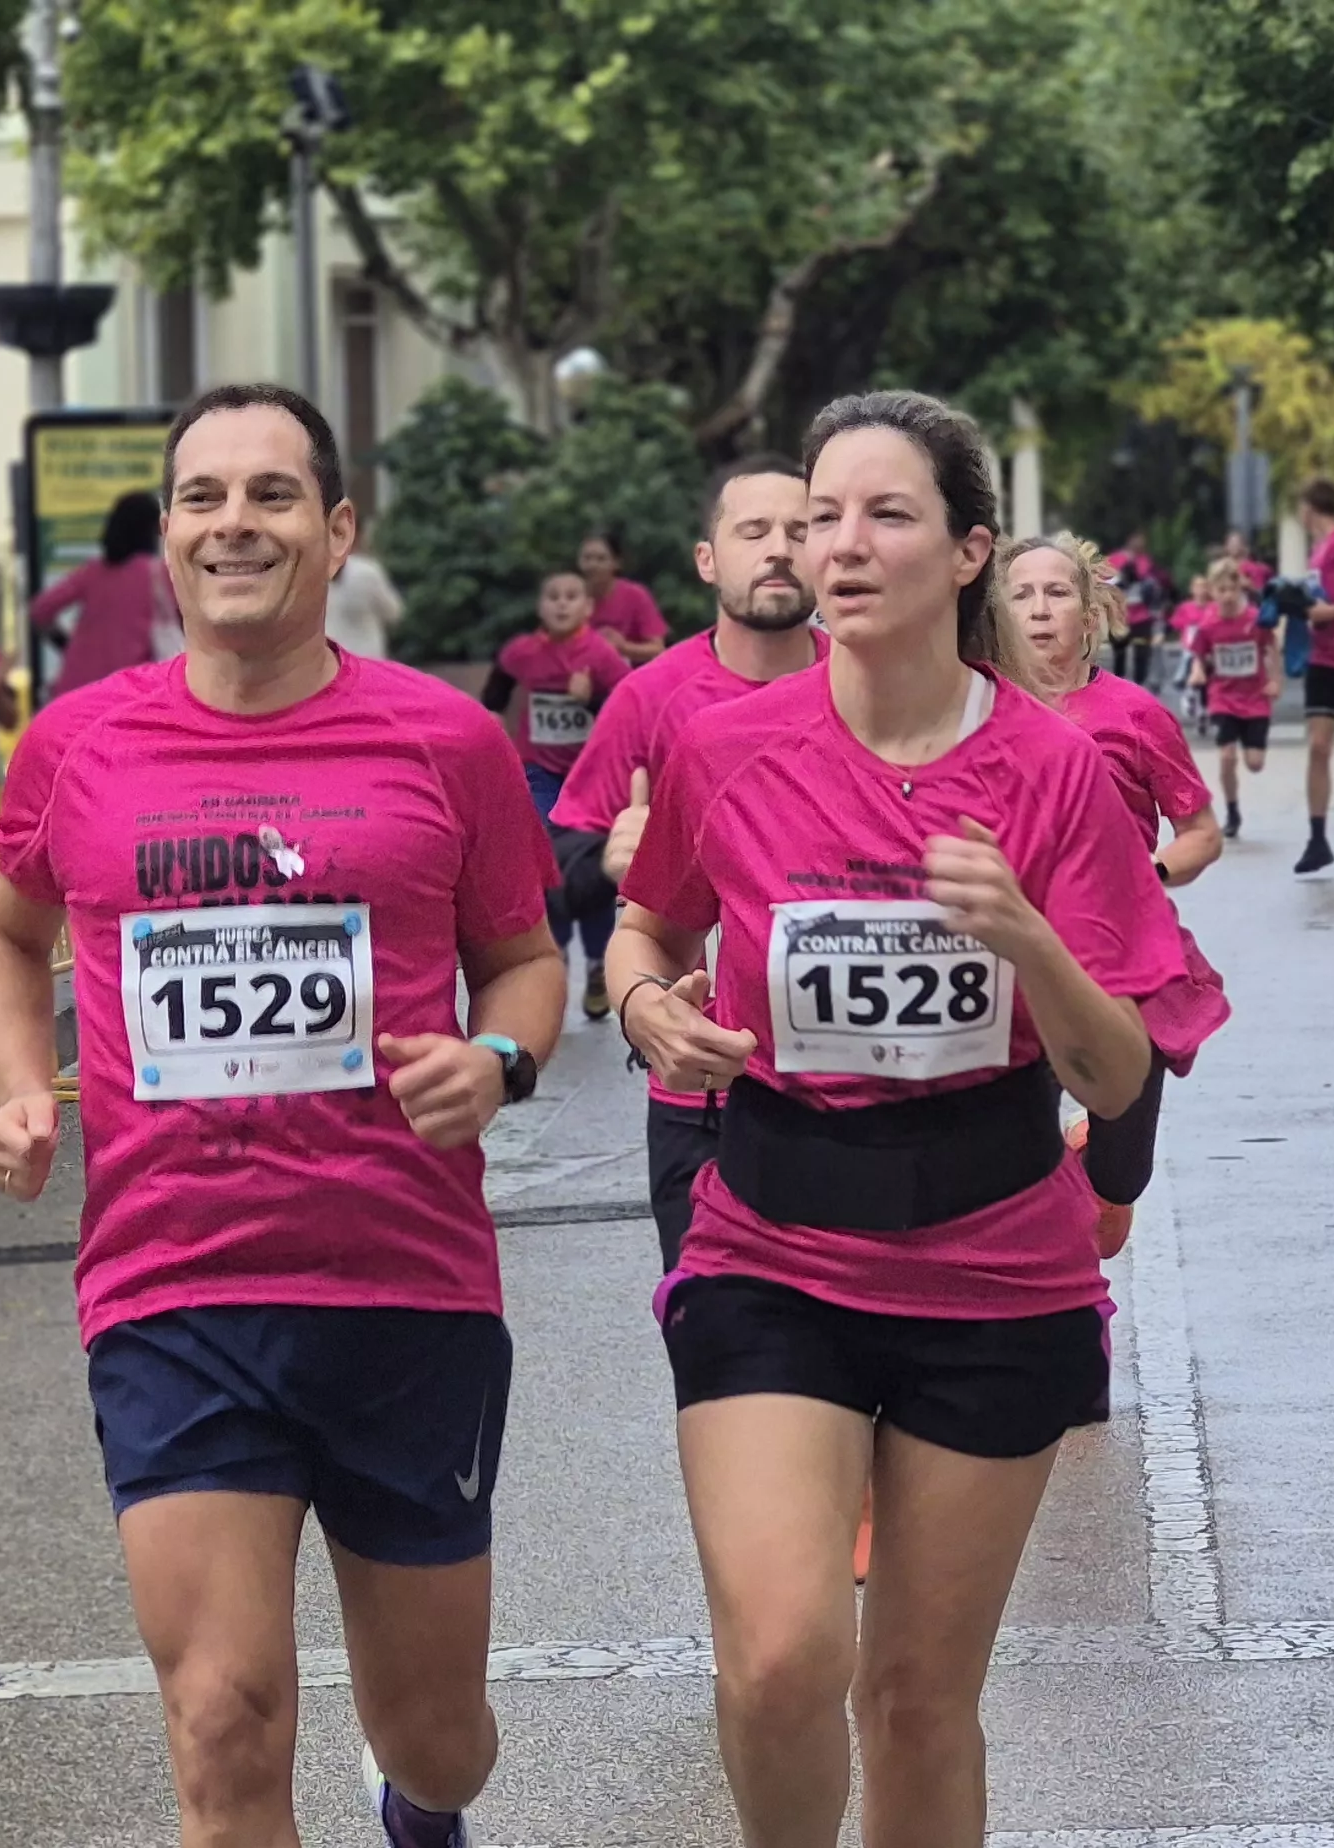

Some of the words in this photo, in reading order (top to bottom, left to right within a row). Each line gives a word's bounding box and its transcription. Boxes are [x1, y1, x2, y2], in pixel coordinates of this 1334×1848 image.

[864, 921, 921, 935] HUESCA
[150, 943, 229, 967] CONTRA
[234, 943, 256, 963] EL
[261, 936, 341, 961] CÁNCER
[797, 935, 877, 952] CONTRA
[883, 936, 904, 953] EL
[151, 972, 347, 1042] 1529
[796, 962, 990, 1027] 1528
